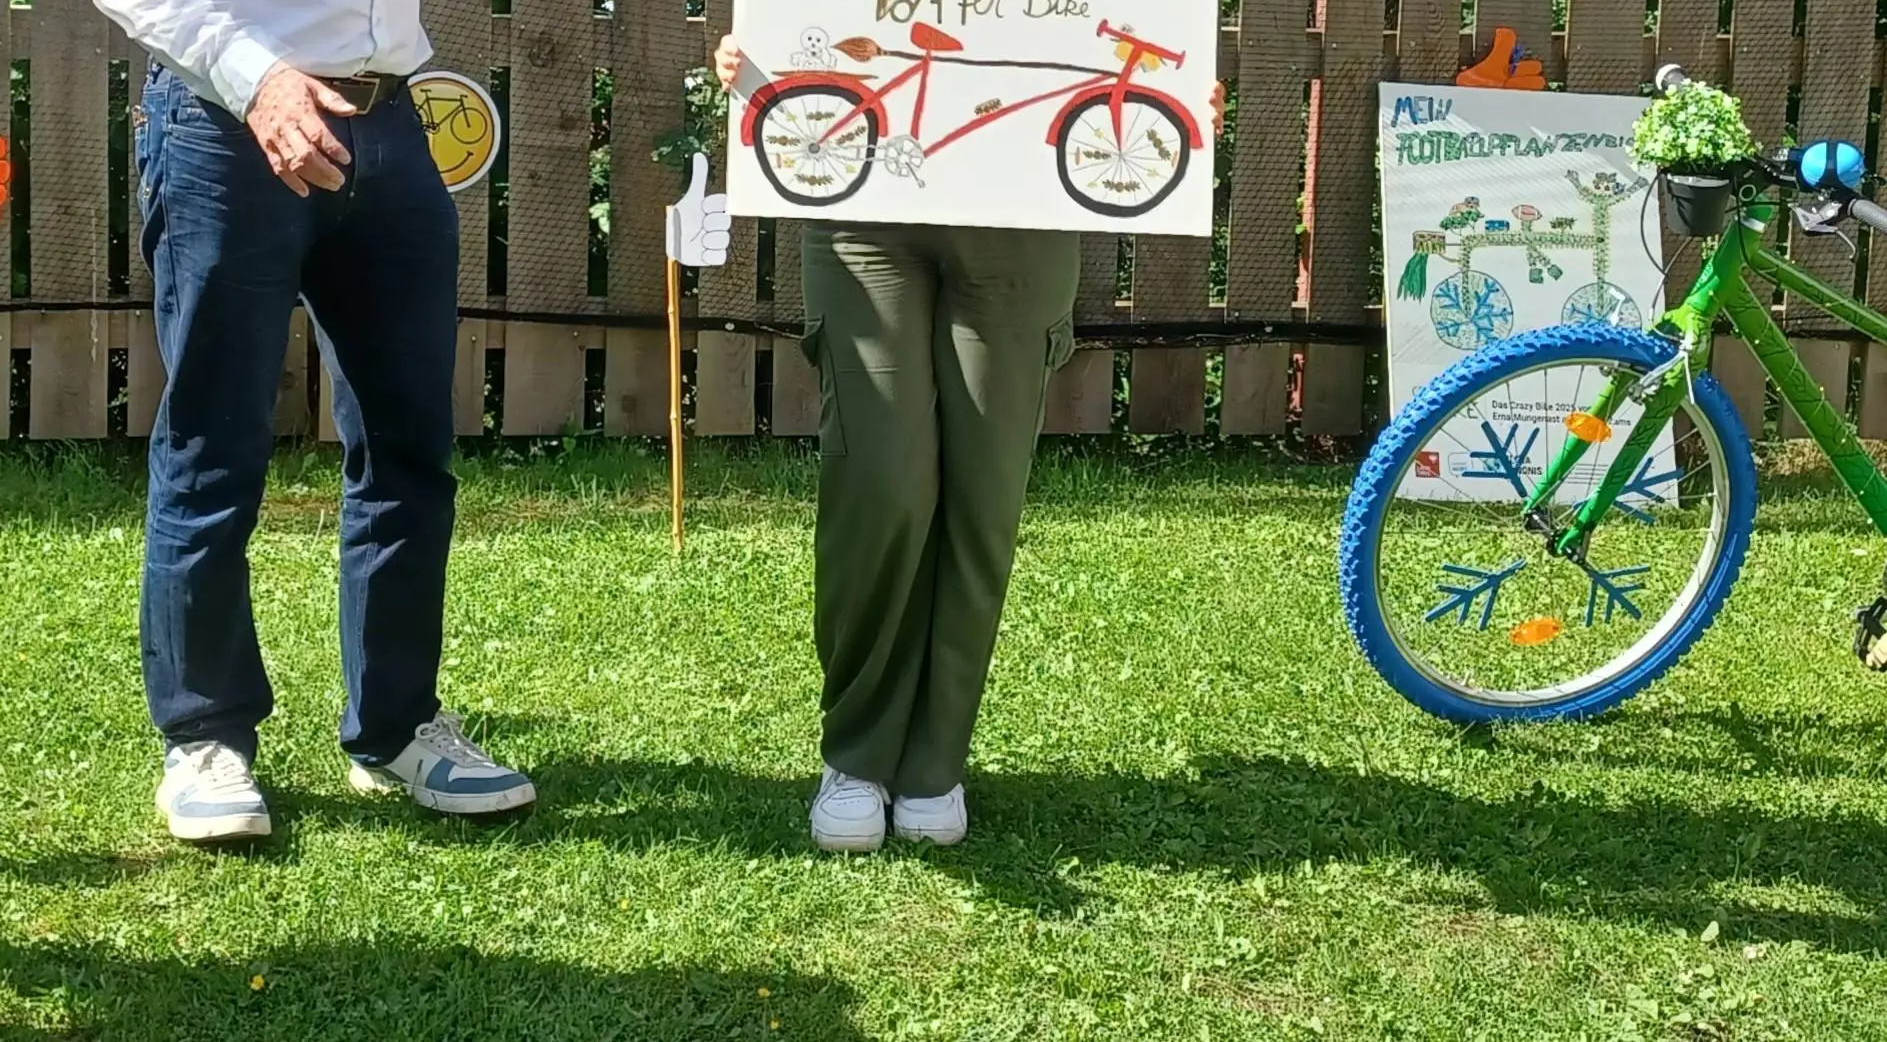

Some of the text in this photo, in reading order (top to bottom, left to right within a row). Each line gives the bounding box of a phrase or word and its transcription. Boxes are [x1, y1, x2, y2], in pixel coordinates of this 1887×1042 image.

[1492, 400, 1508, 409] Das
[1510, 401, 1533, 412] Crazy
[1493, 412, 1511, 421] Erna
